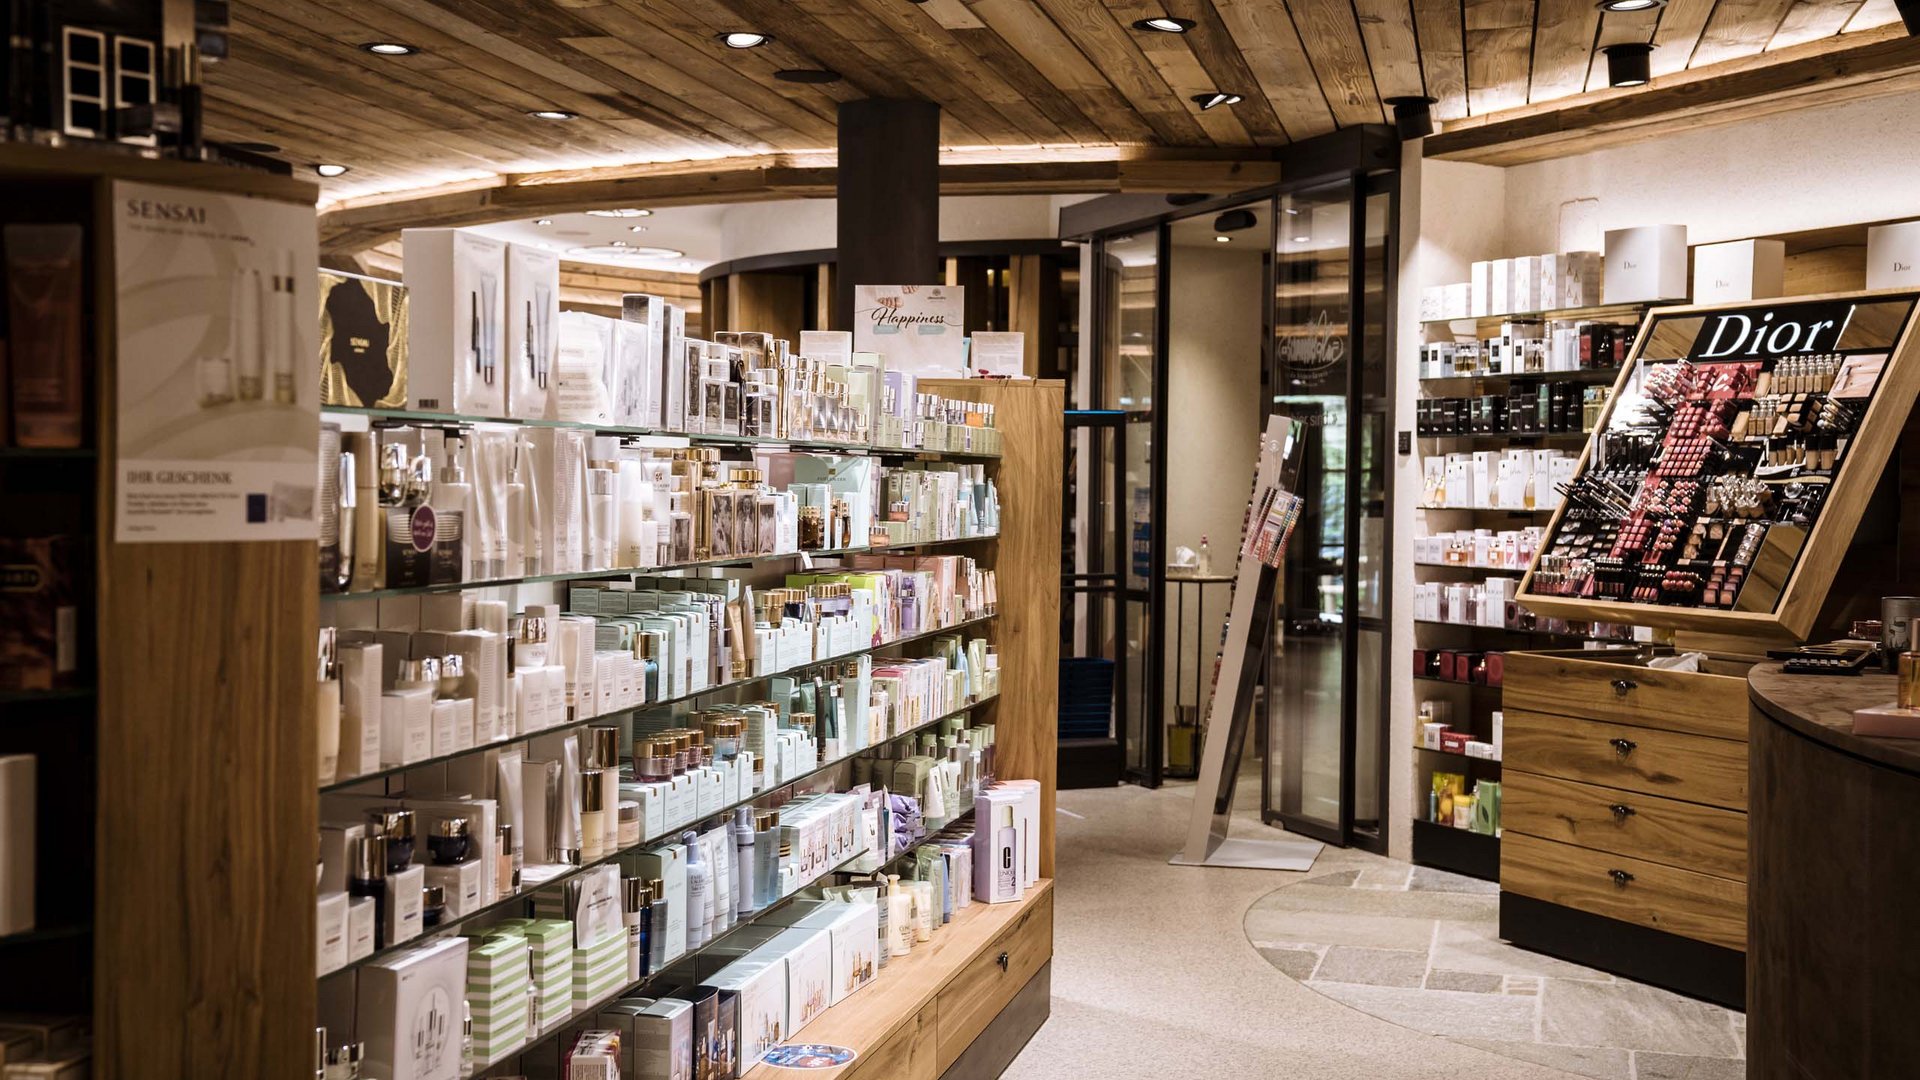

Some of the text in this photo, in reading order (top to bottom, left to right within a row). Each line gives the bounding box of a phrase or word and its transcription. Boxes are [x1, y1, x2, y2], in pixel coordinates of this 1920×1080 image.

[126, 200, 207, 224] SENSAI
[1893, 262, 1912, 273] Dior
[870, 306, 946, 329] Happiness
[1698, 311, 1834, 358] Dior
[126, 470, 233, 485] IHR GESCHENK
